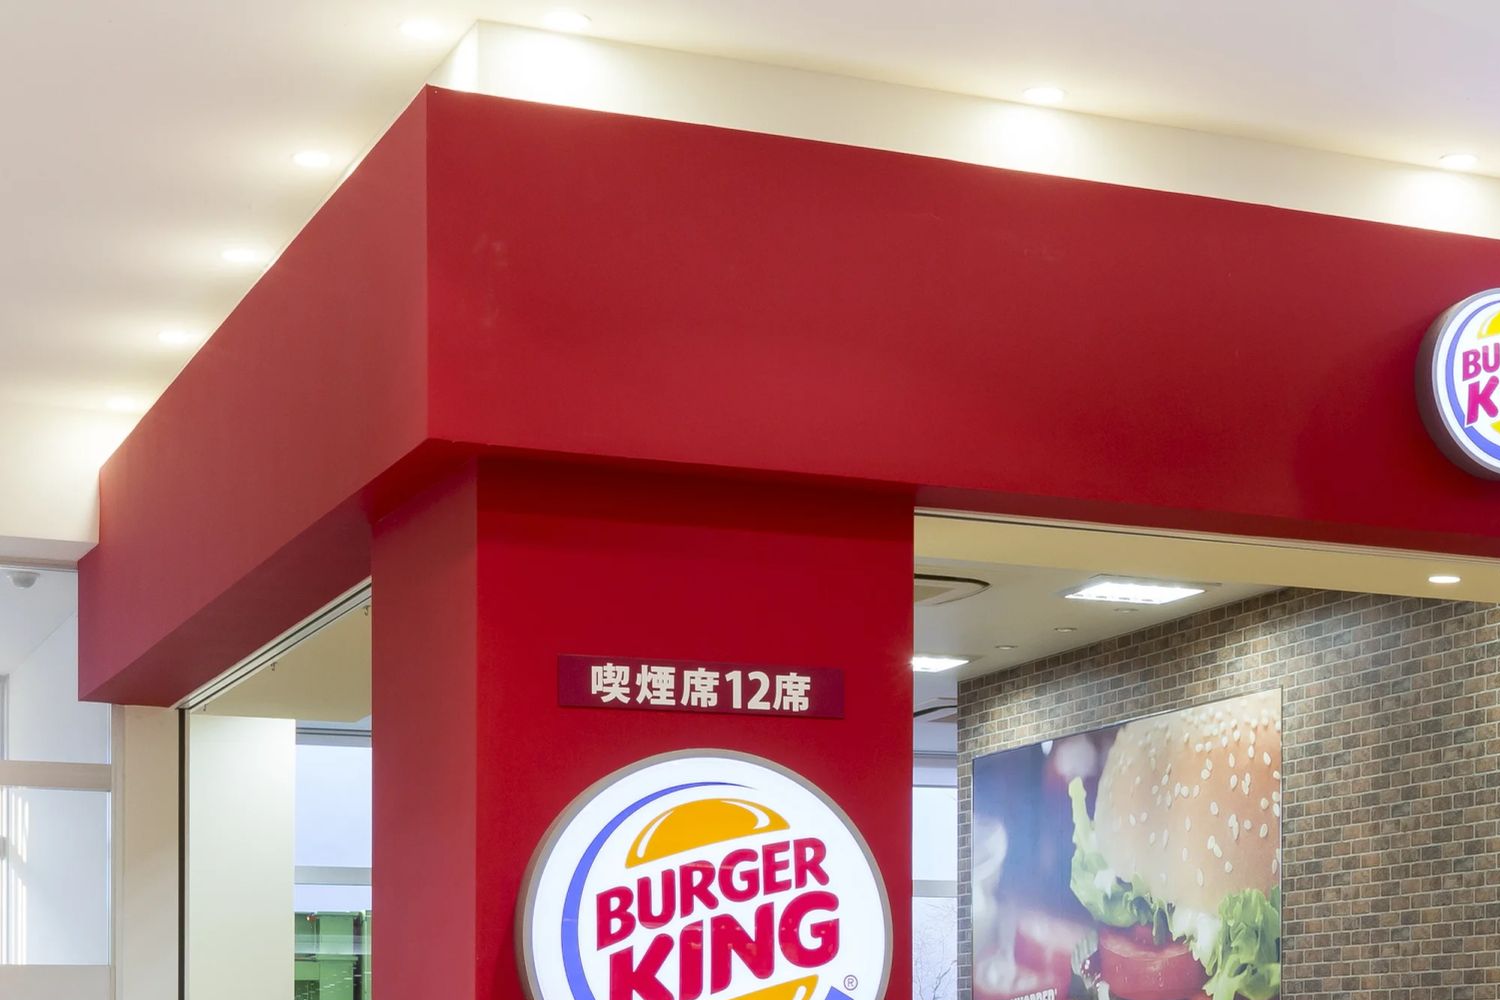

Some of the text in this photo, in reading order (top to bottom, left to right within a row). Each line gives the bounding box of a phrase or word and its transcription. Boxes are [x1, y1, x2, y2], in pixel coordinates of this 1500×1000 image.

[590, 663, 812, 712] 喫煙席12席
[596, 837, 829, 951] BURGER
